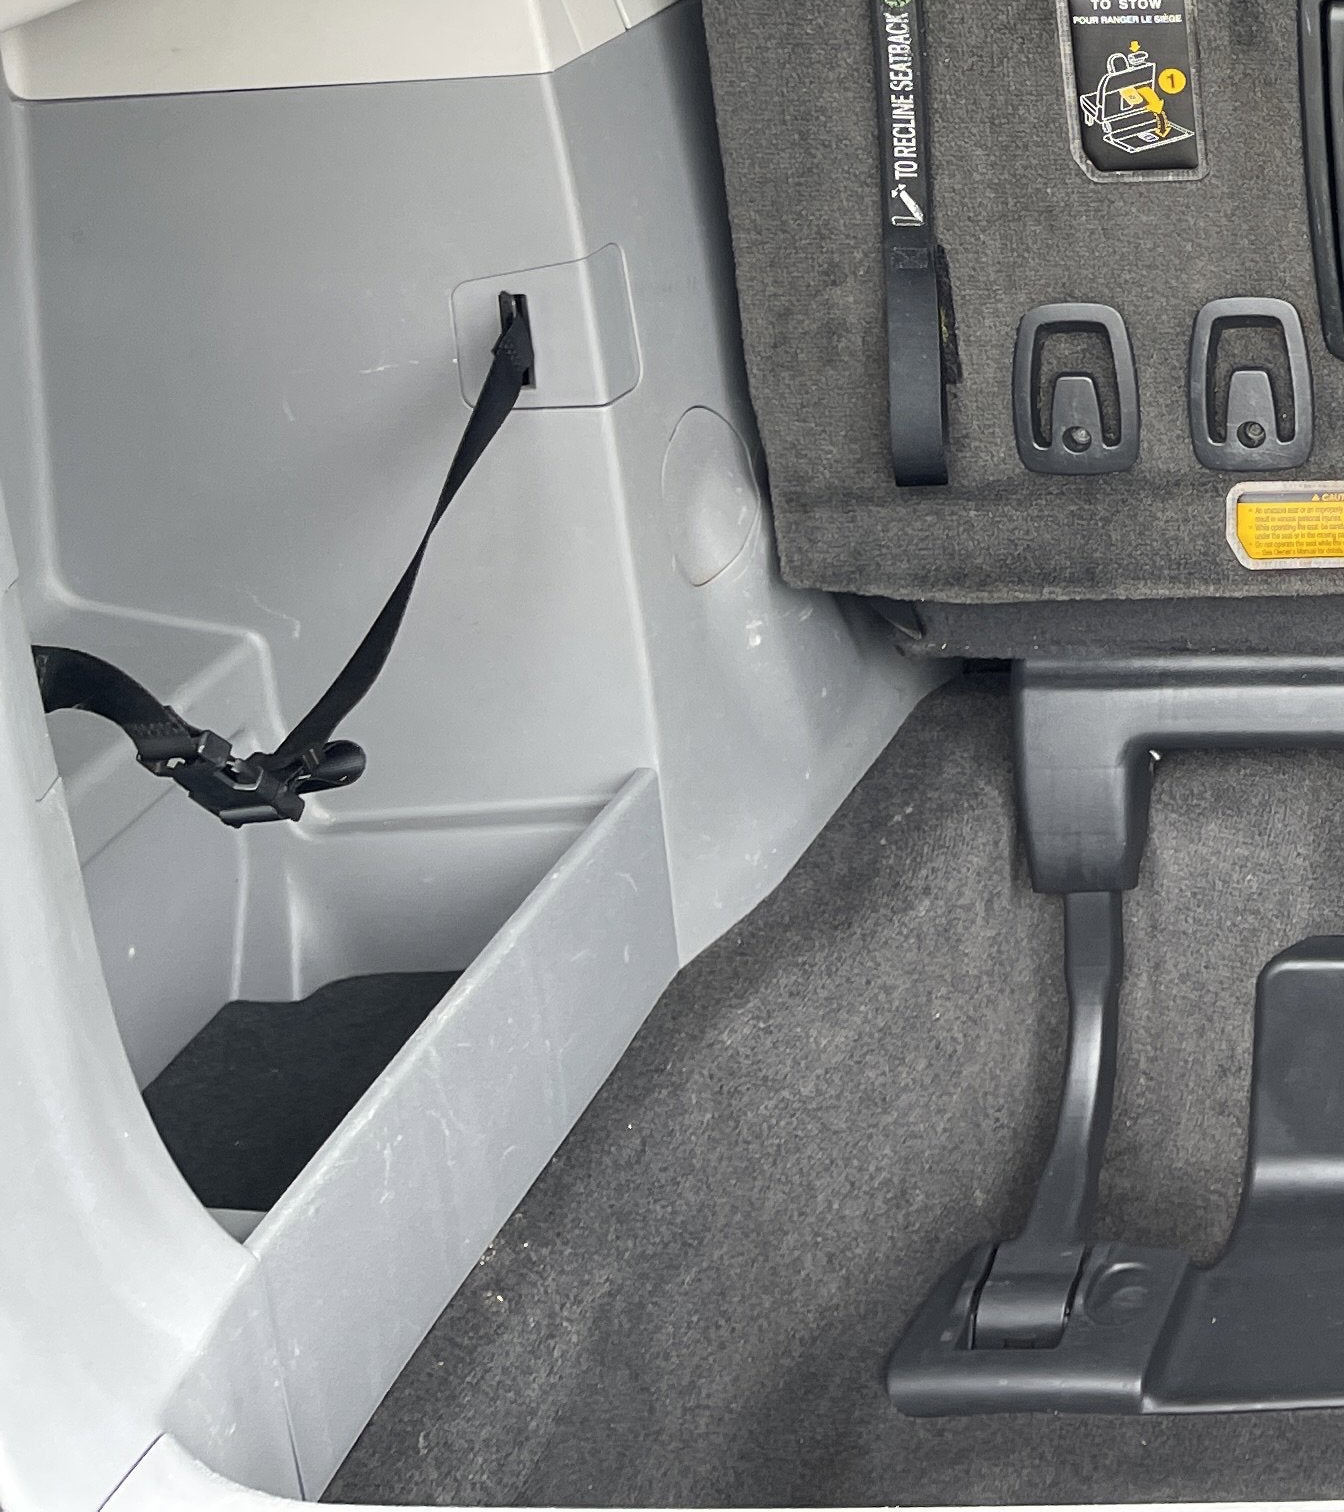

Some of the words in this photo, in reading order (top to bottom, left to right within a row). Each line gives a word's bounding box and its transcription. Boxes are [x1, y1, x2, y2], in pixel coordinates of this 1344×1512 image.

[1091, 0, 1111, 10] TO
[1073, 16, 1099, 24] POUR
[1100, 16, 1139, 24] RANGER
[1141, 15, 1152, 23] LE
[883, 12, 914, 91] SEATBACK
[1166, 74, 1175, 88] 1
[891, 94, 917, 157] RECLINE
[894, 160, 918, 180] TO
